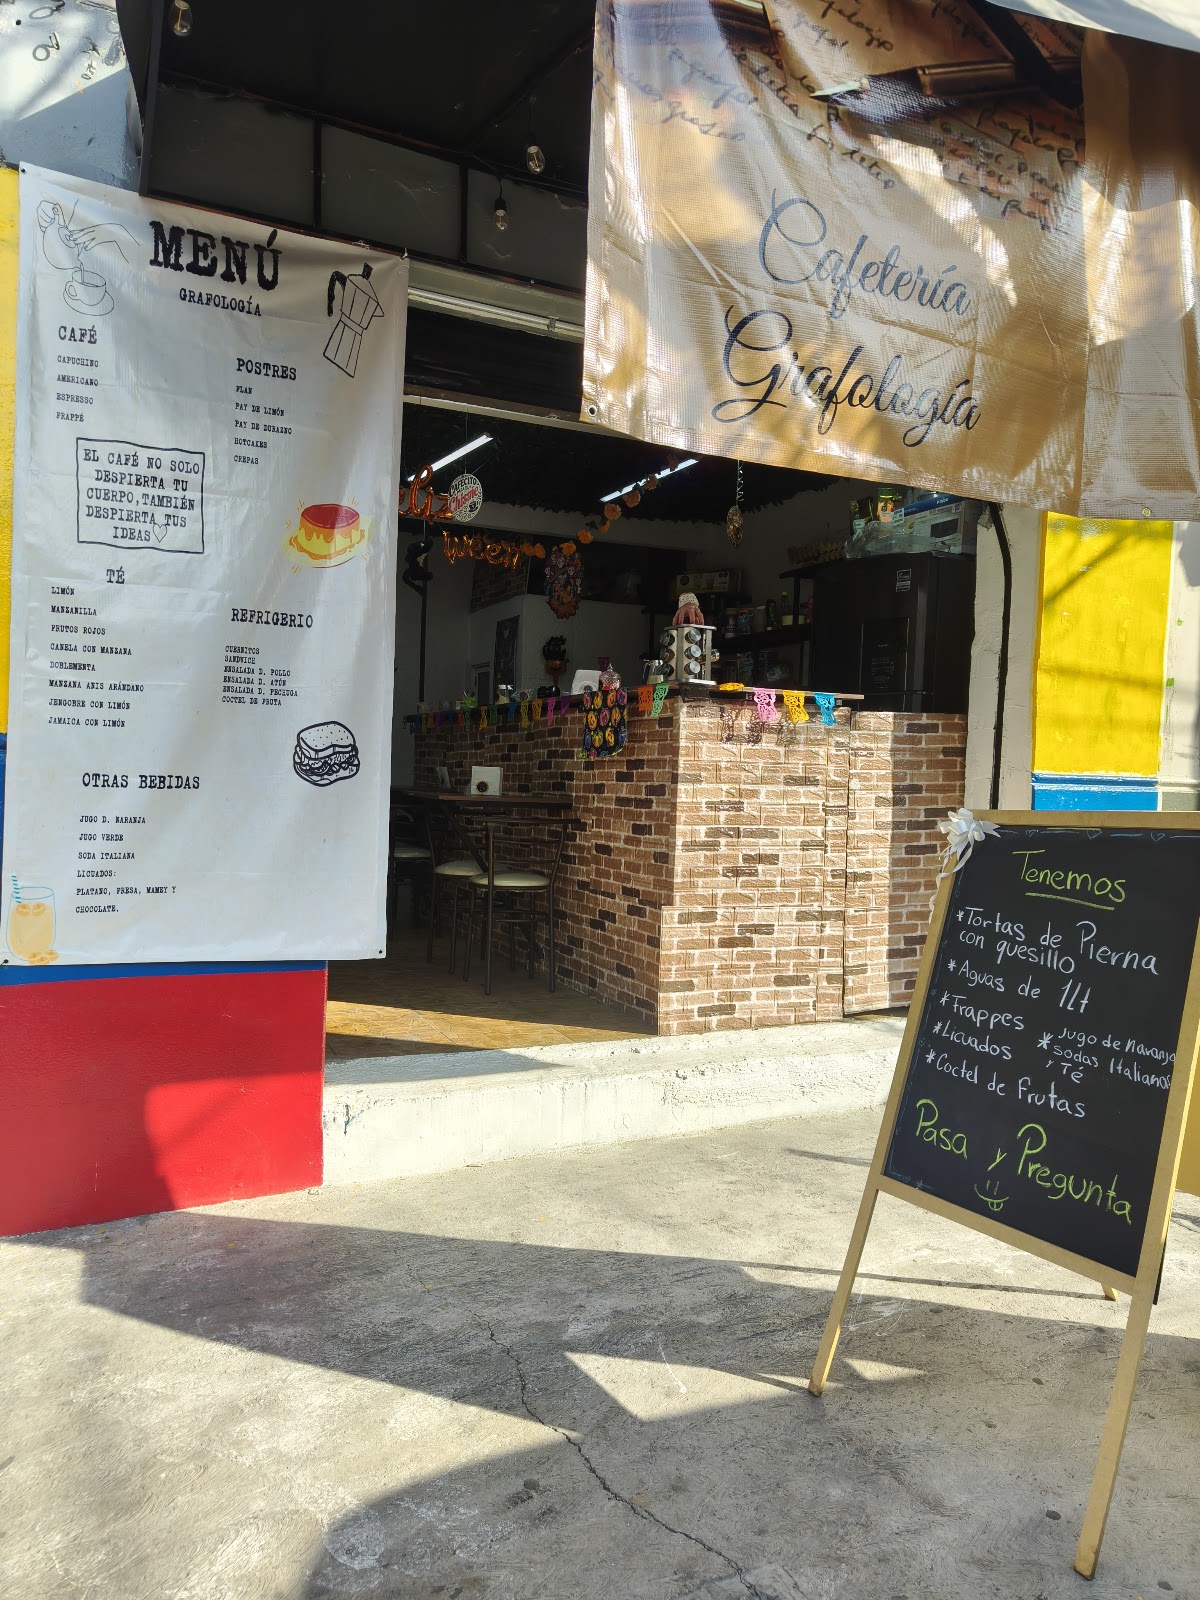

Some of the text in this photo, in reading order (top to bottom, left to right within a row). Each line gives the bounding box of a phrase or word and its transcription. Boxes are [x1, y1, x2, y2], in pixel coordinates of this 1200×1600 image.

[149, 220, 283, 291] MENÚ
[759, 188, 971, 320] Cafetería
[179, 287, 262, 316] GRAFOLOGÍA
[58, 325, 98, 344] CAFÉ
[57, 355, 99, 368] CAPUCHINO
[236, 357, 297, 381] POSTRES
[711, 304, 981, 447] Grafología
[56, 374, 99, 387] AMERICANO
[235, 385, 253, 395] FLAN
[56, 392, 94, 405] ESPRESSO
[234, 402, 285, 417] PAY DE LIMÓN
[56, 411, 85, 423] FRAPPÉ
[234, 419, 293, 435] PAY DE DURAZNO
[234, 437, 268, 449] HOTCAKES
[83, 448, 200, 475] EL CAFÉ NO SOLO
[233, 454, 259, 465] CREPAS
[94, 469, 189, 492] DESPIERTA TU
[449, 476, 478, 498] CAFECITO
[85, 504, 187, 528] DESPIERTA TUS
[112, 526, 152, 542] IDEAS
[105, 565, 126, 584] TÉ
[51, 586, 75, 596] LIMÓN
[50, 605, 98, 616] MANZANILLA
[230, 607, 314, 629] REFRIGERIO
[50, 624, 106, 635] FRUTOS ROJOS
[50, 642, 132, 656] CANELA CON MANZANA
[224, 645, 260, 655] CUERNITOS
[49, 660, 97, 672] DOBLEMENTA
[224, 655, 256, 665] SANDWICH
[223, 665, 291, 677] ENSALADA D. POLLO
[48, 679, 145, 692] MANZANA ANIS ARÁNDANO
[222, 675, 287, 687] ENSALADA D. ATÚN
[222, 685, 298, 697] ENSALADA D. PECHUGA
[89, 700, 104, 709] CON
[107, 700, 131, 710] LIMÓN
[221, 695, 282, 706] COCTEL DE FRUTA
[48, 716, 126, 728] JAMAICA CON LIMÓN
[82, 772, 200, 790] OTRAS BEBIDAS
[79, 815, 146, 824] JUGO D. NARANJA
[78, 833, 124, 842] JUGO VERDE
[78, 851, 136, 860] SODA ITALIANA
[76, 869, 117, 878] LICUADOS:
[1012, 849, 1126, 903] Tenemos
[76, 885, 177, 897] PLATANO, FRESA, MAMEY Y
[75, 904, 120, 914] CHOCOLATE.
[965, 906, 1160, 976] Tortas de Pierna
[959, 929, 1076, 974] con quesillo
[957, 959, 1005, 993] Aguas
[1017, 975, 1041, 999] de
[941, 1019, 1013, 1060] Licuados
[1101, 1033, 1121, 1051] de
[936, 1053, 979, 1084] Coctel
[987, 1071, 1006, 1096] de
[1060, 1061, 1084, 1085] Té
[915, 1098, 968, 1161] Pasa
[1016, 1122, 1132, 1226] Pregunta
